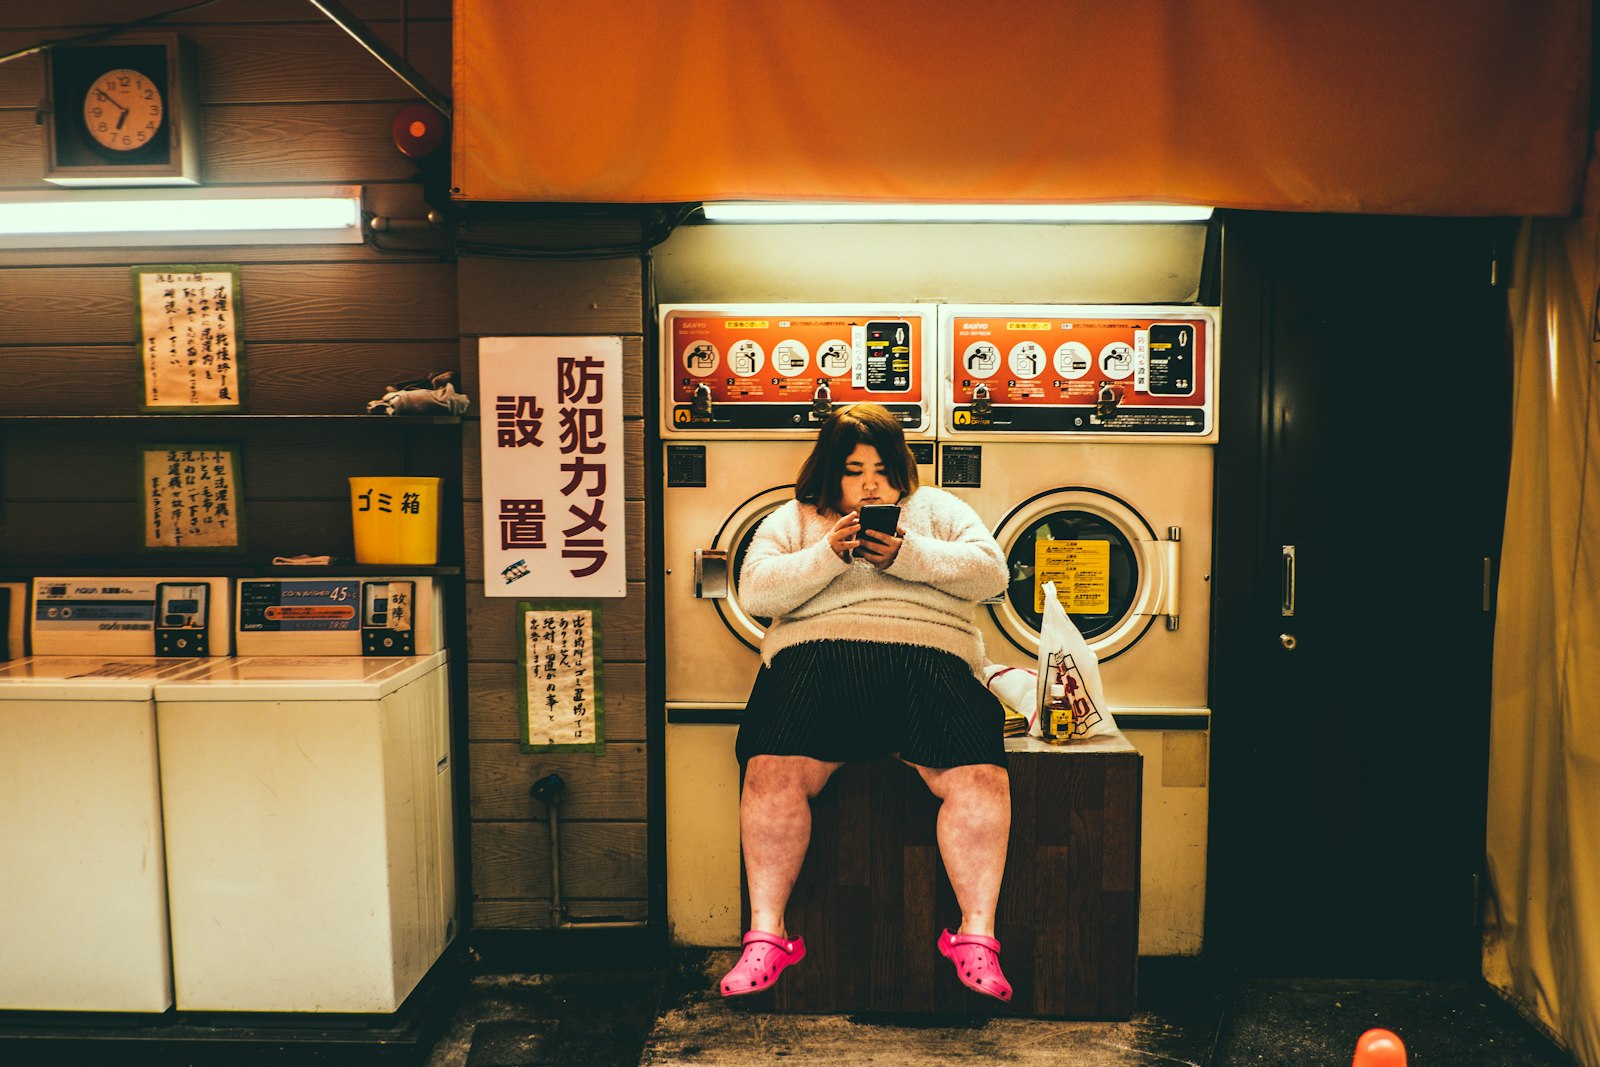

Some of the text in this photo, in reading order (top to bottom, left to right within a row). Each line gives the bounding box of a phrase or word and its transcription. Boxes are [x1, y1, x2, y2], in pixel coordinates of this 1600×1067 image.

[119, 76, 130, 87] 12
[144, 89, 153, 100] 2
[93, 106, 102, 118] 9
[150, 105, 159, 116] 3
[99, 122, 107, 133] 8
[146, 120, 154, 129] 4
[110, 132, 118, 143] 7
[122, 135, 131, 146] 6
[137, 131, 145, 142] 5
[557, 356, 608, 578] 防犯カメラ
[495, 396, 547, 551] 設置
[358, 488, 420, 514] ゴミ箱
